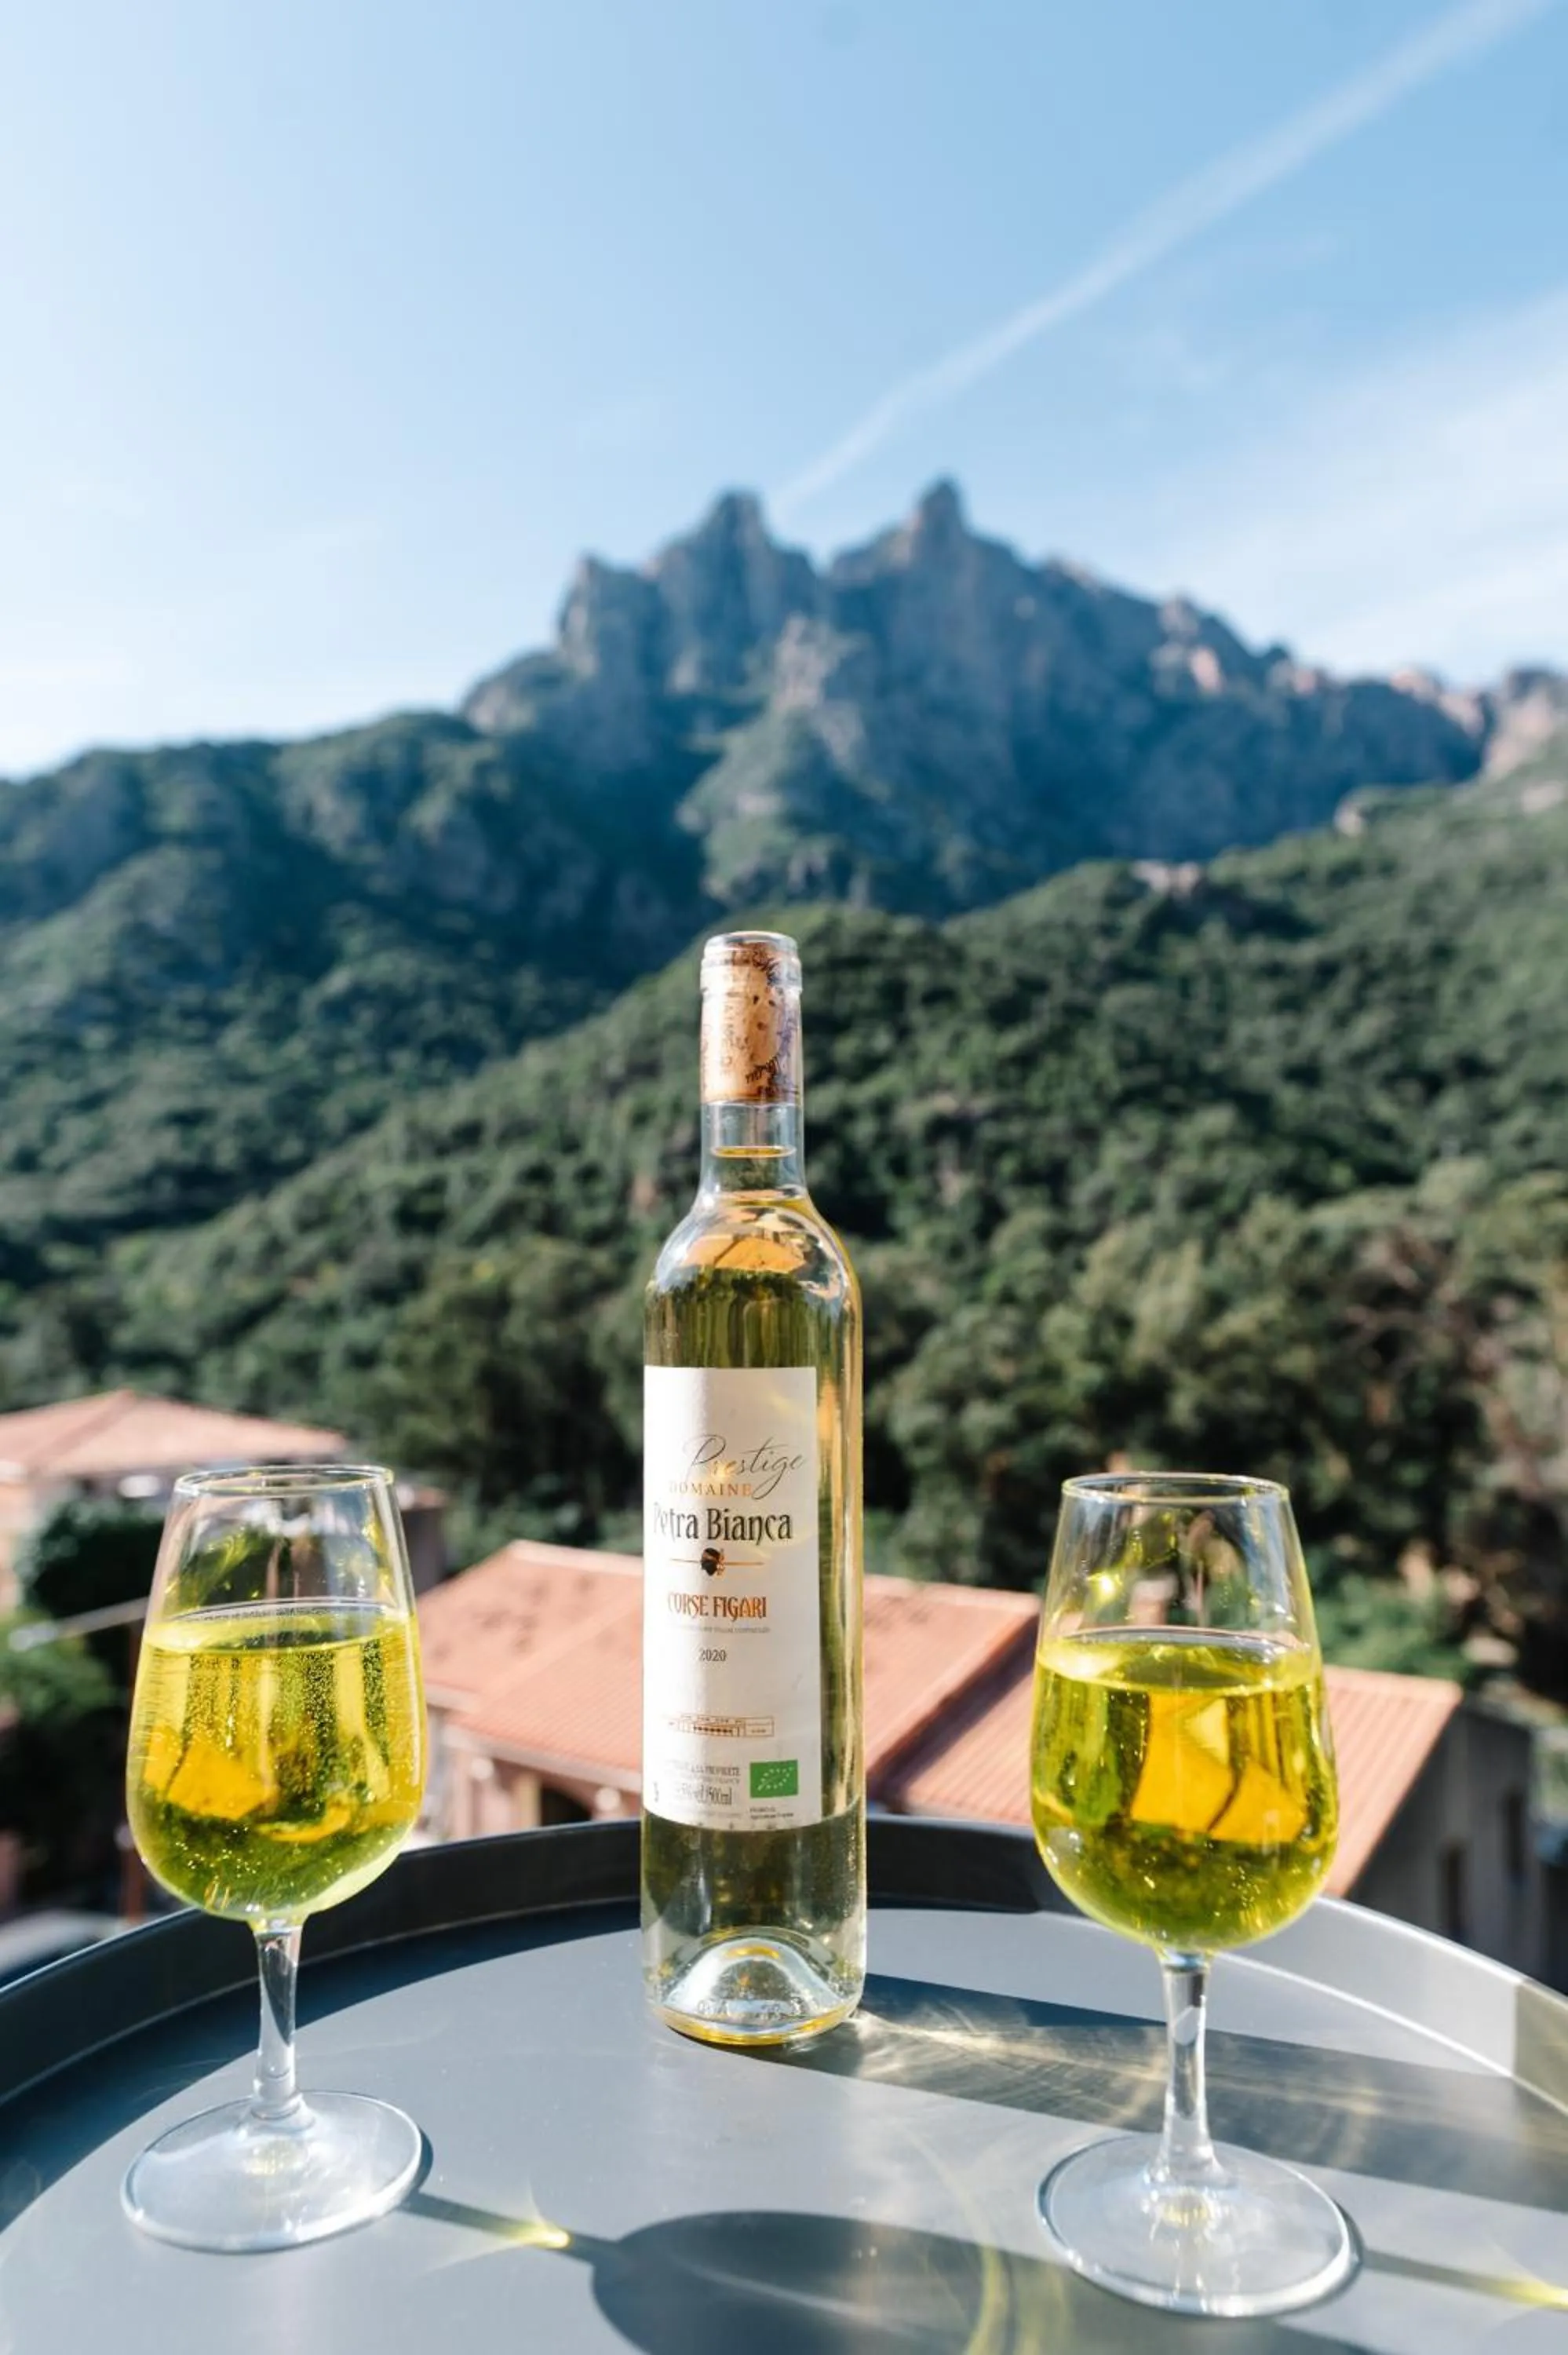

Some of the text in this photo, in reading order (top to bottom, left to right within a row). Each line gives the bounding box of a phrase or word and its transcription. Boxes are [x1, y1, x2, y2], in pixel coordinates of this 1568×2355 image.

[683, 1433, 806, 1500] Prestige
[669, 1480, 753, 1496] DOMAINE
[707, 1508, 792, 1546] Bianca
[667, 1591, 767, 1622] CORSE FIGARI
[699, 1648, 727, 1662] 2020
